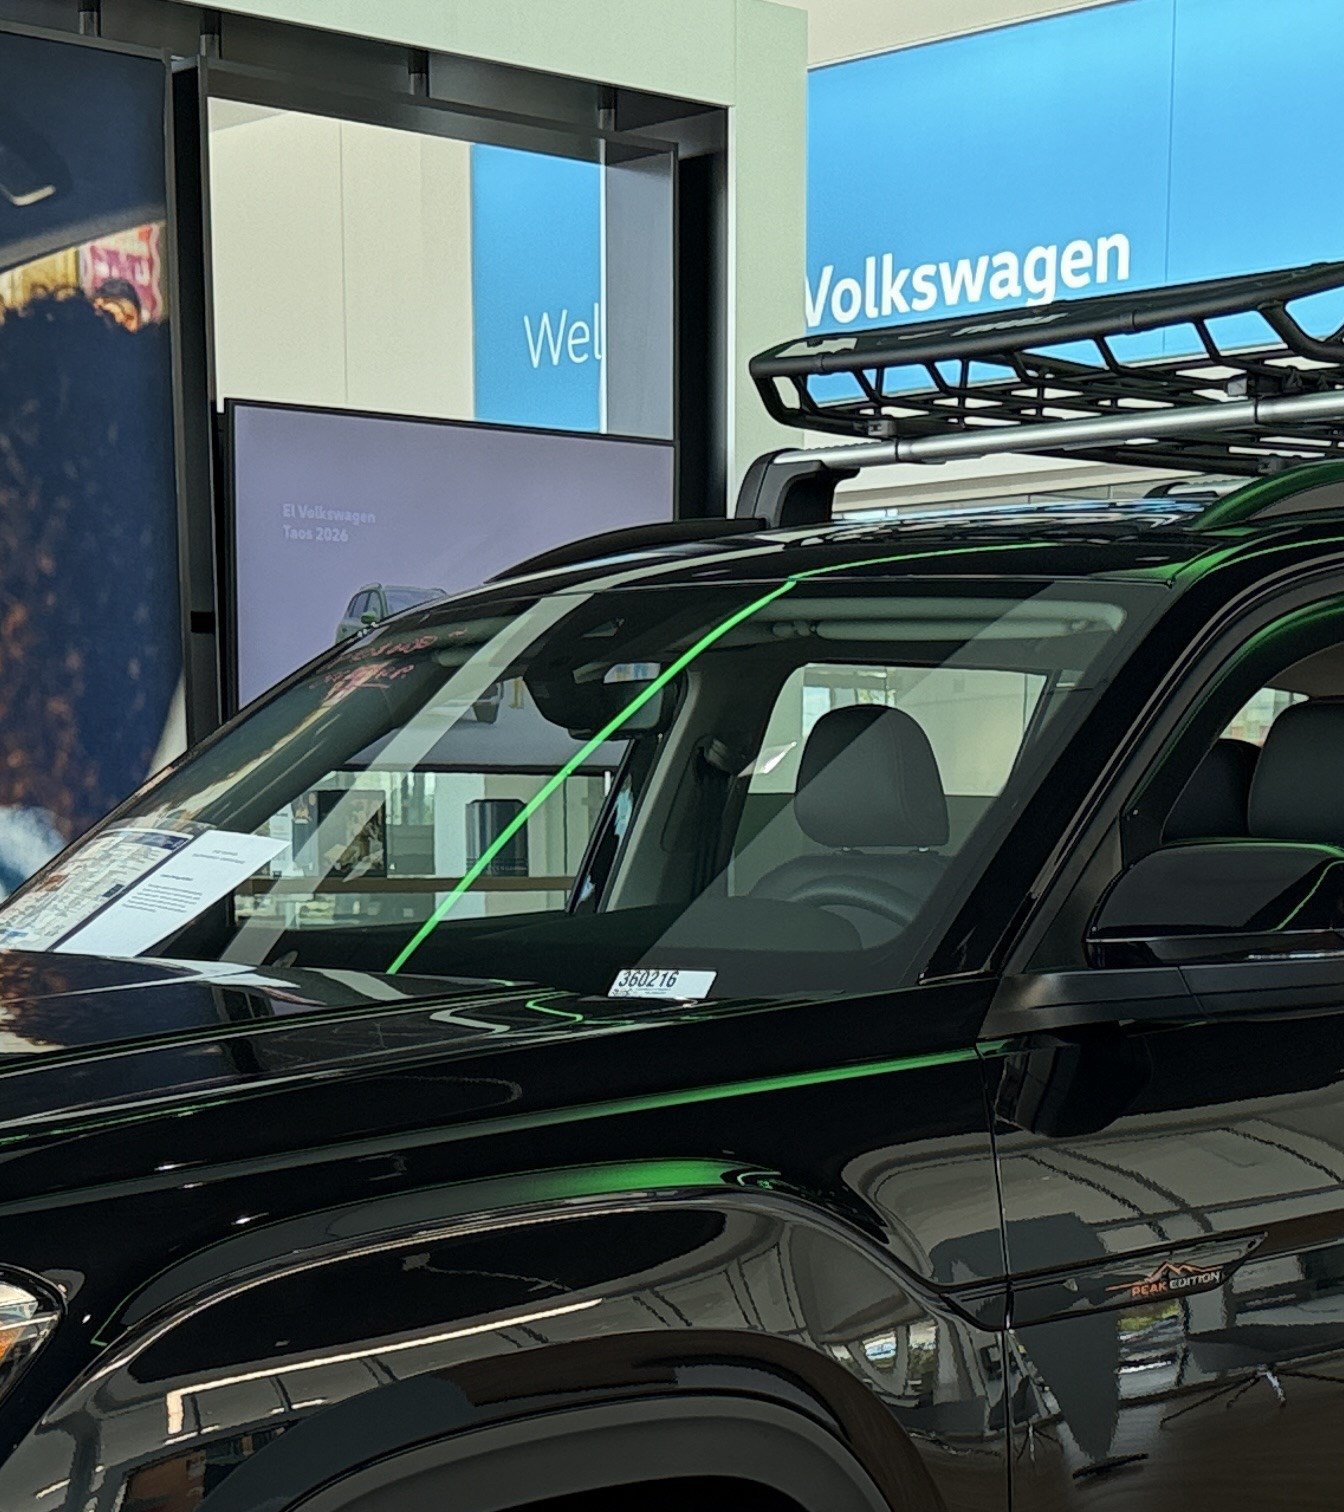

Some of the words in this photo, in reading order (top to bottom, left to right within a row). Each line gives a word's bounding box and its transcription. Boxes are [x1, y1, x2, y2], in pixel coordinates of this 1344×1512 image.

[805, 233, 1131, 328] Volkswagen
[298, 504, 377, 526] Volkswagen
[618, 970, 679, 988] 360216
[1131, 1283, 1168, 1298] PEAK
[1169, 1271, 1221, 1290] EDITION
